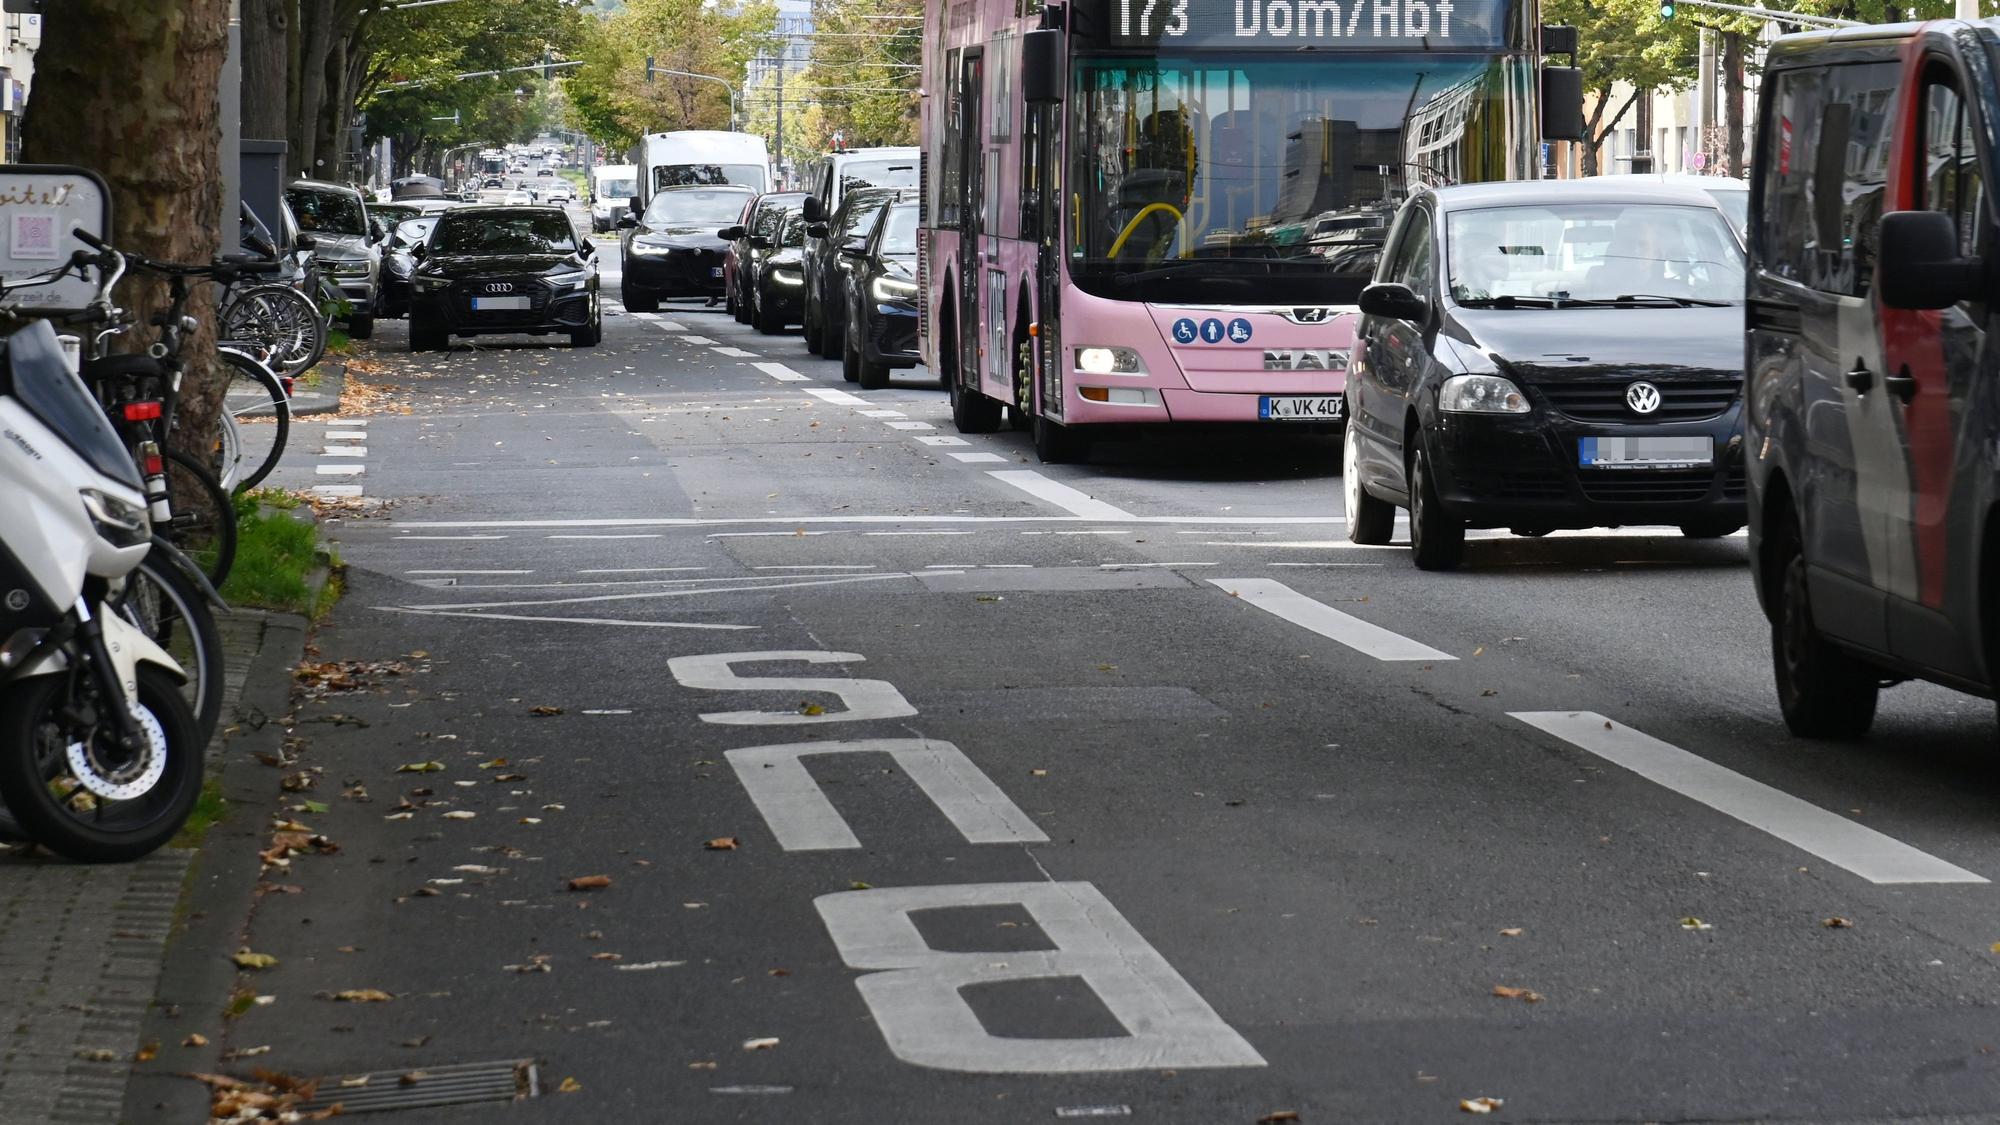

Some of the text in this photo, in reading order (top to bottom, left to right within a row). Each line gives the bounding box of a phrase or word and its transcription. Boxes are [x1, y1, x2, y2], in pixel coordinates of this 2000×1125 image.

[1121, 0, 1454, 37] 173 Dom/Hbf
[1264, 351, 1350, 370] MAN
[1271, 400, 1281, 415] K
[1293, 400, 1313, 415] VK
